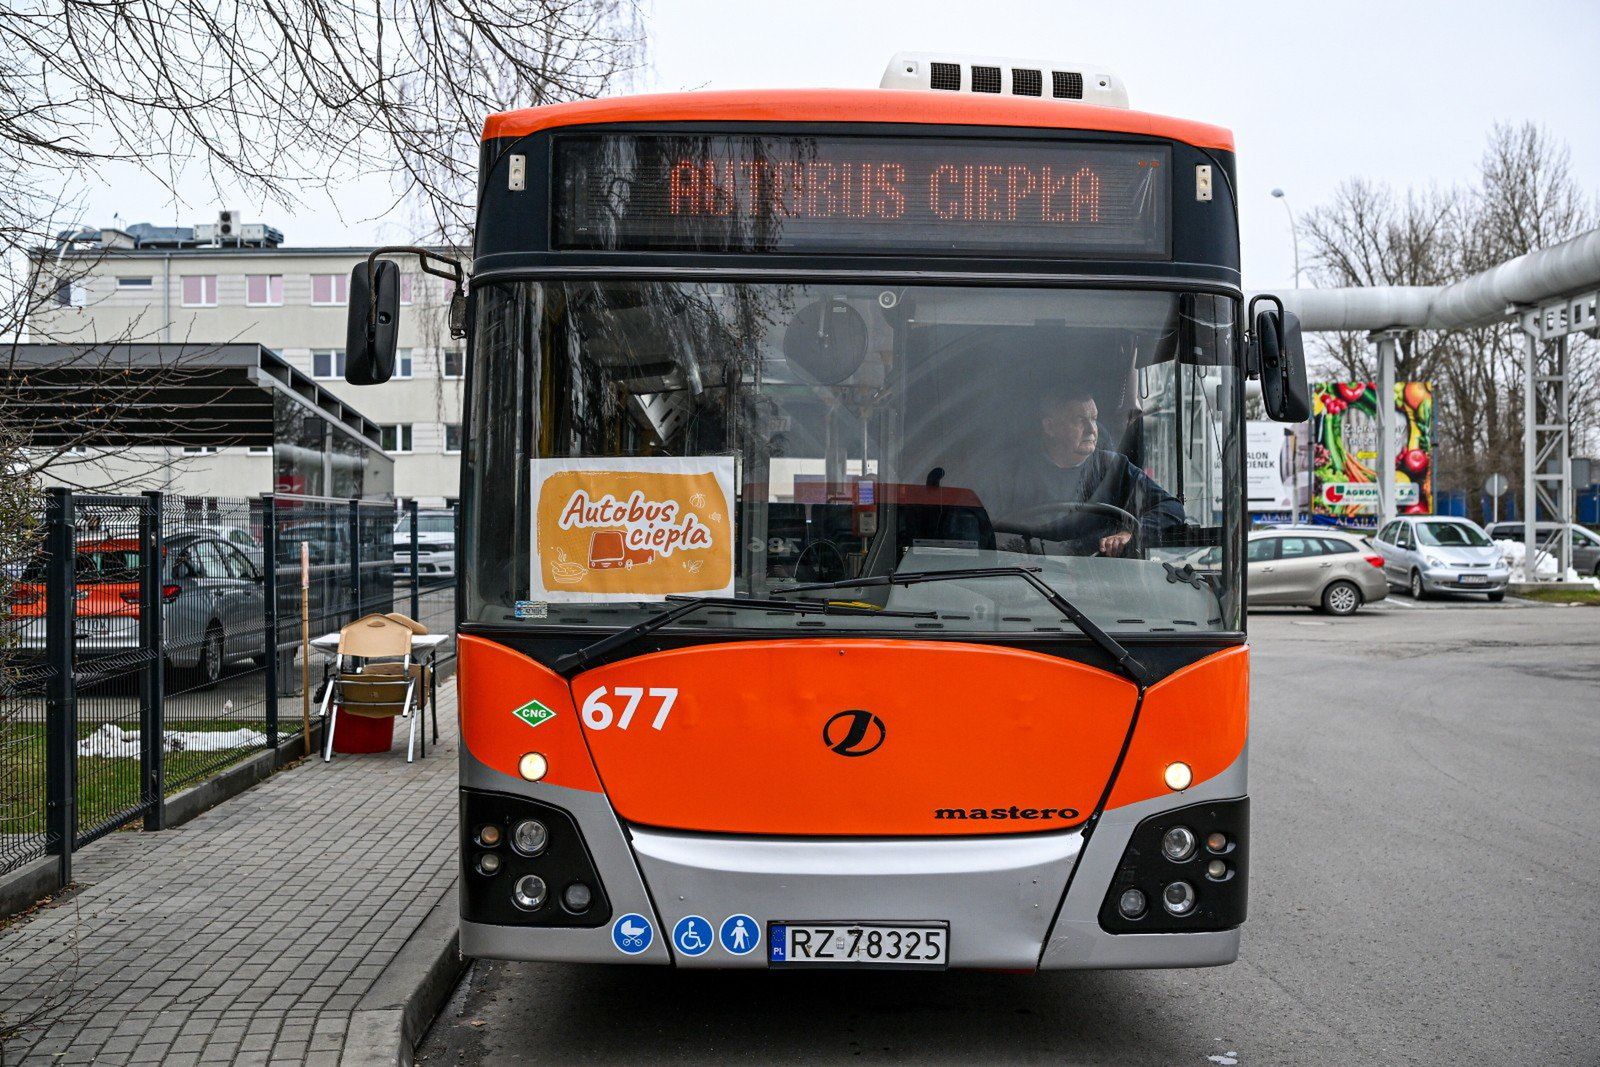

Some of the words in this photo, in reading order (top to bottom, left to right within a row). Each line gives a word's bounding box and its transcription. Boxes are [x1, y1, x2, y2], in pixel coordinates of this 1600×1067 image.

[668, 160, 906, 218] AUTOBUS
[928, 163, 1100, 223] CIEPŁA
[562, 492, 676, 526] Autobus
[629, 517, 709, 553] ciepła
[521, 707, 547, 719] CNG
[581, 685, 679, 731] 677
[934, 804, 1080, 820] mastero
[790, 929, 834, 958] RZ
[846, 929, 941, 961] 78325
